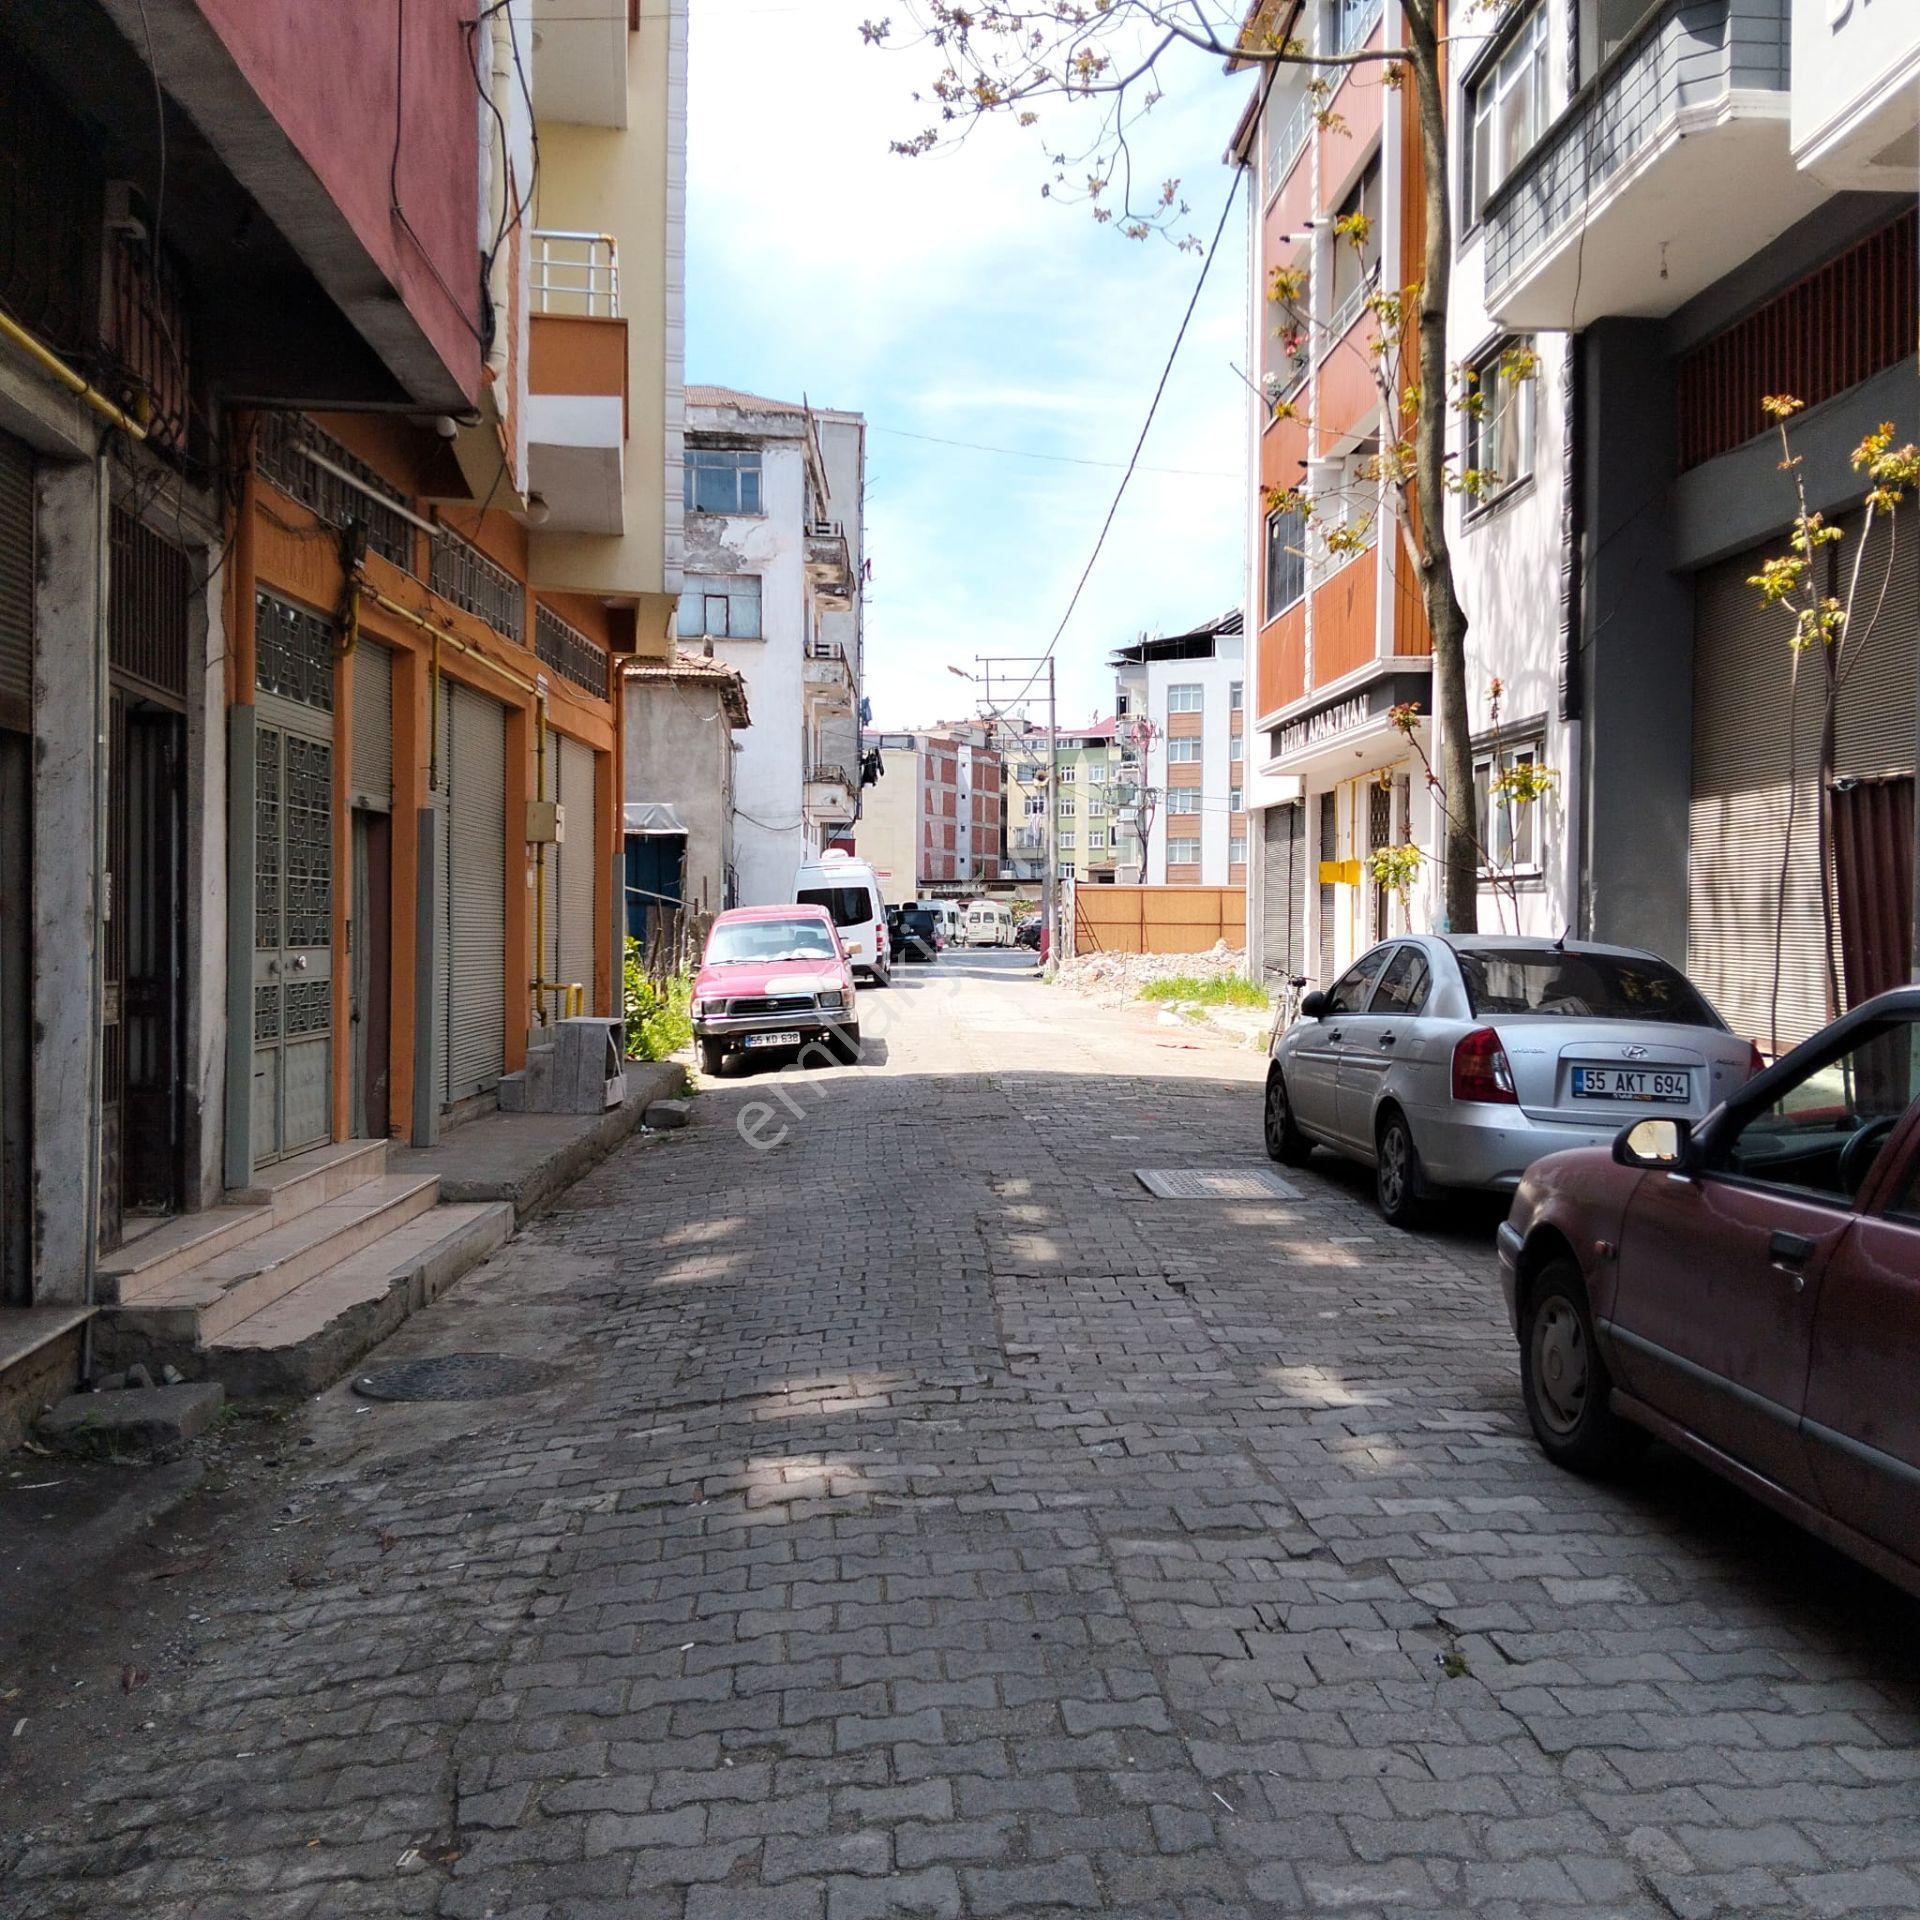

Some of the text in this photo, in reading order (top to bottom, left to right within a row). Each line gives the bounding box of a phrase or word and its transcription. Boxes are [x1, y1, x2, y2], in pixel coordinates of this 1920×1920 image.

[1309, 694, 1371, 743] APARTMAN
[751, 1035, 763, 1045] 55
[781, 1033, 799, 1043] 638
[1585, 1071, 1684, 1094] 55 AKT 694
